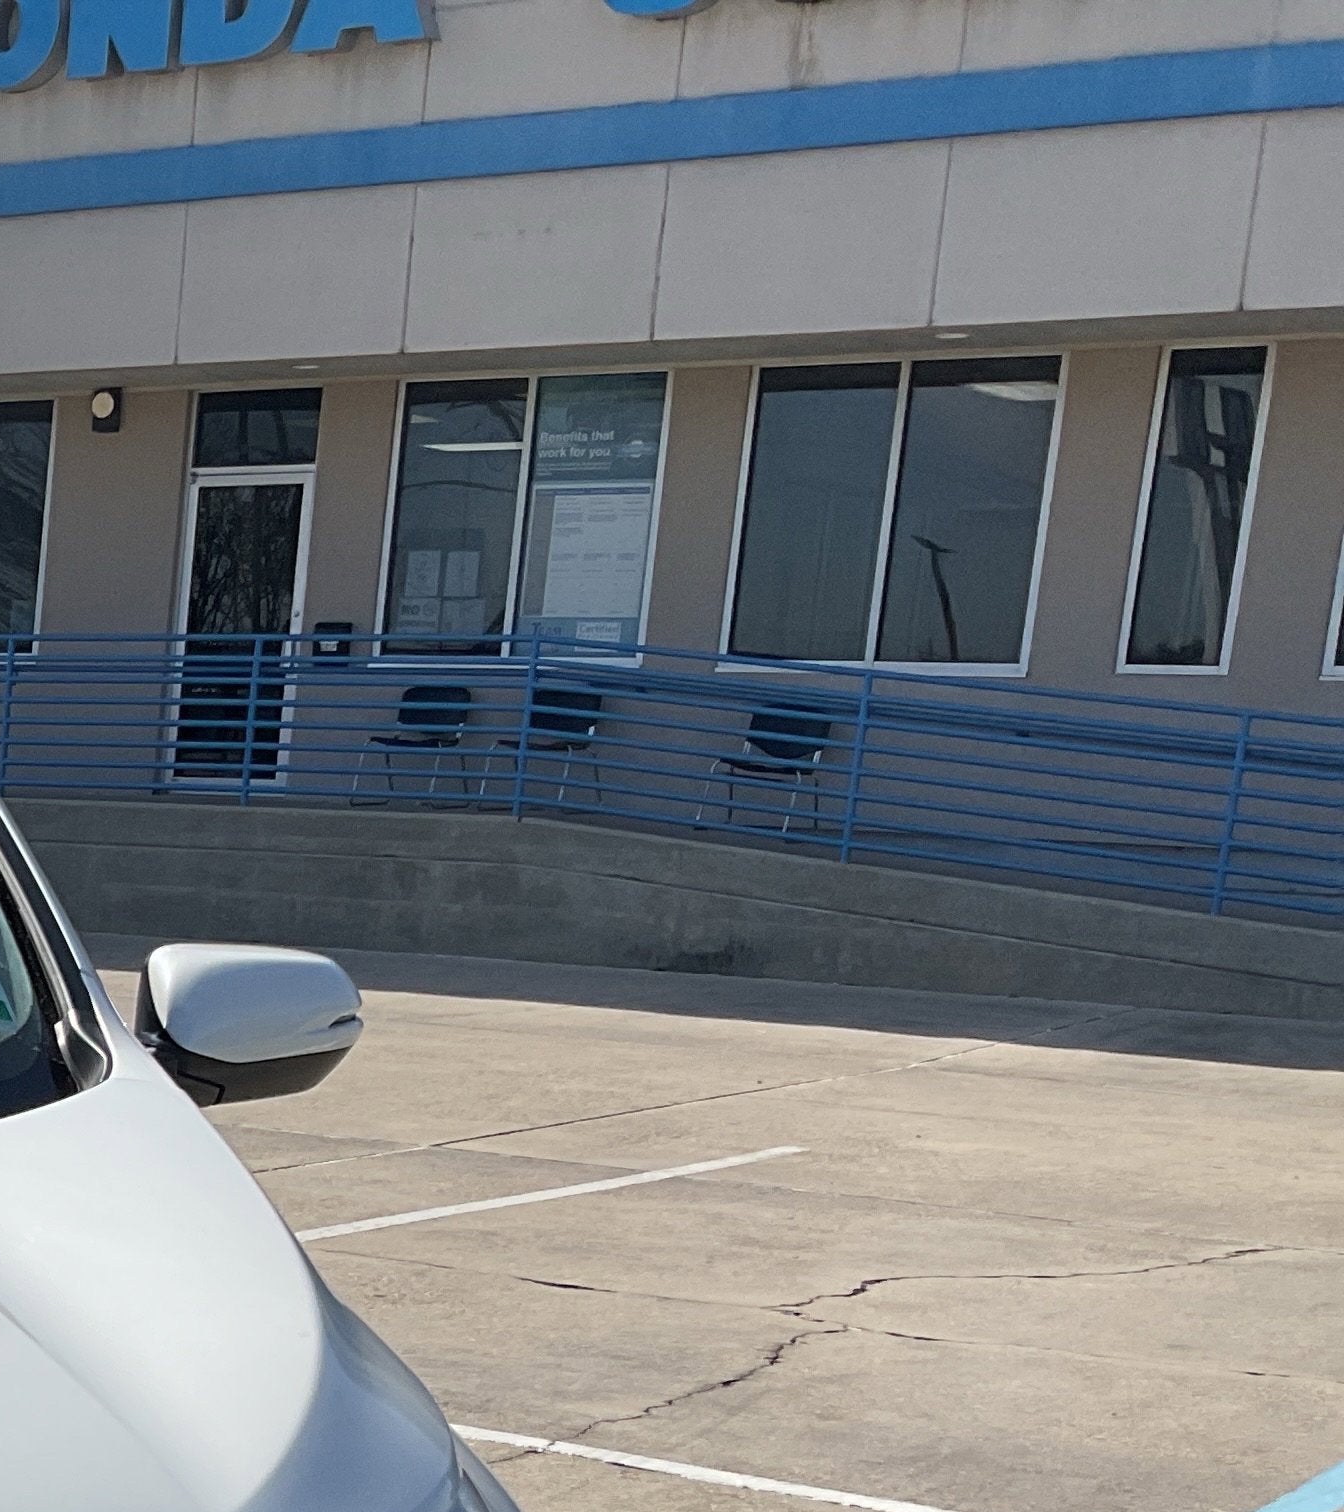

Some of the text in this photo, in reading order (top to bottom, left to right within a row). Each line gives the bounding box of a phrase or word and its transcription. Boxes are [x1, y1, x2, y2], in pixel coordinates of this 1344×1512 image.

[540, 430, 615, 442] Benefits that
[538, 447, 611, 459] work for you
